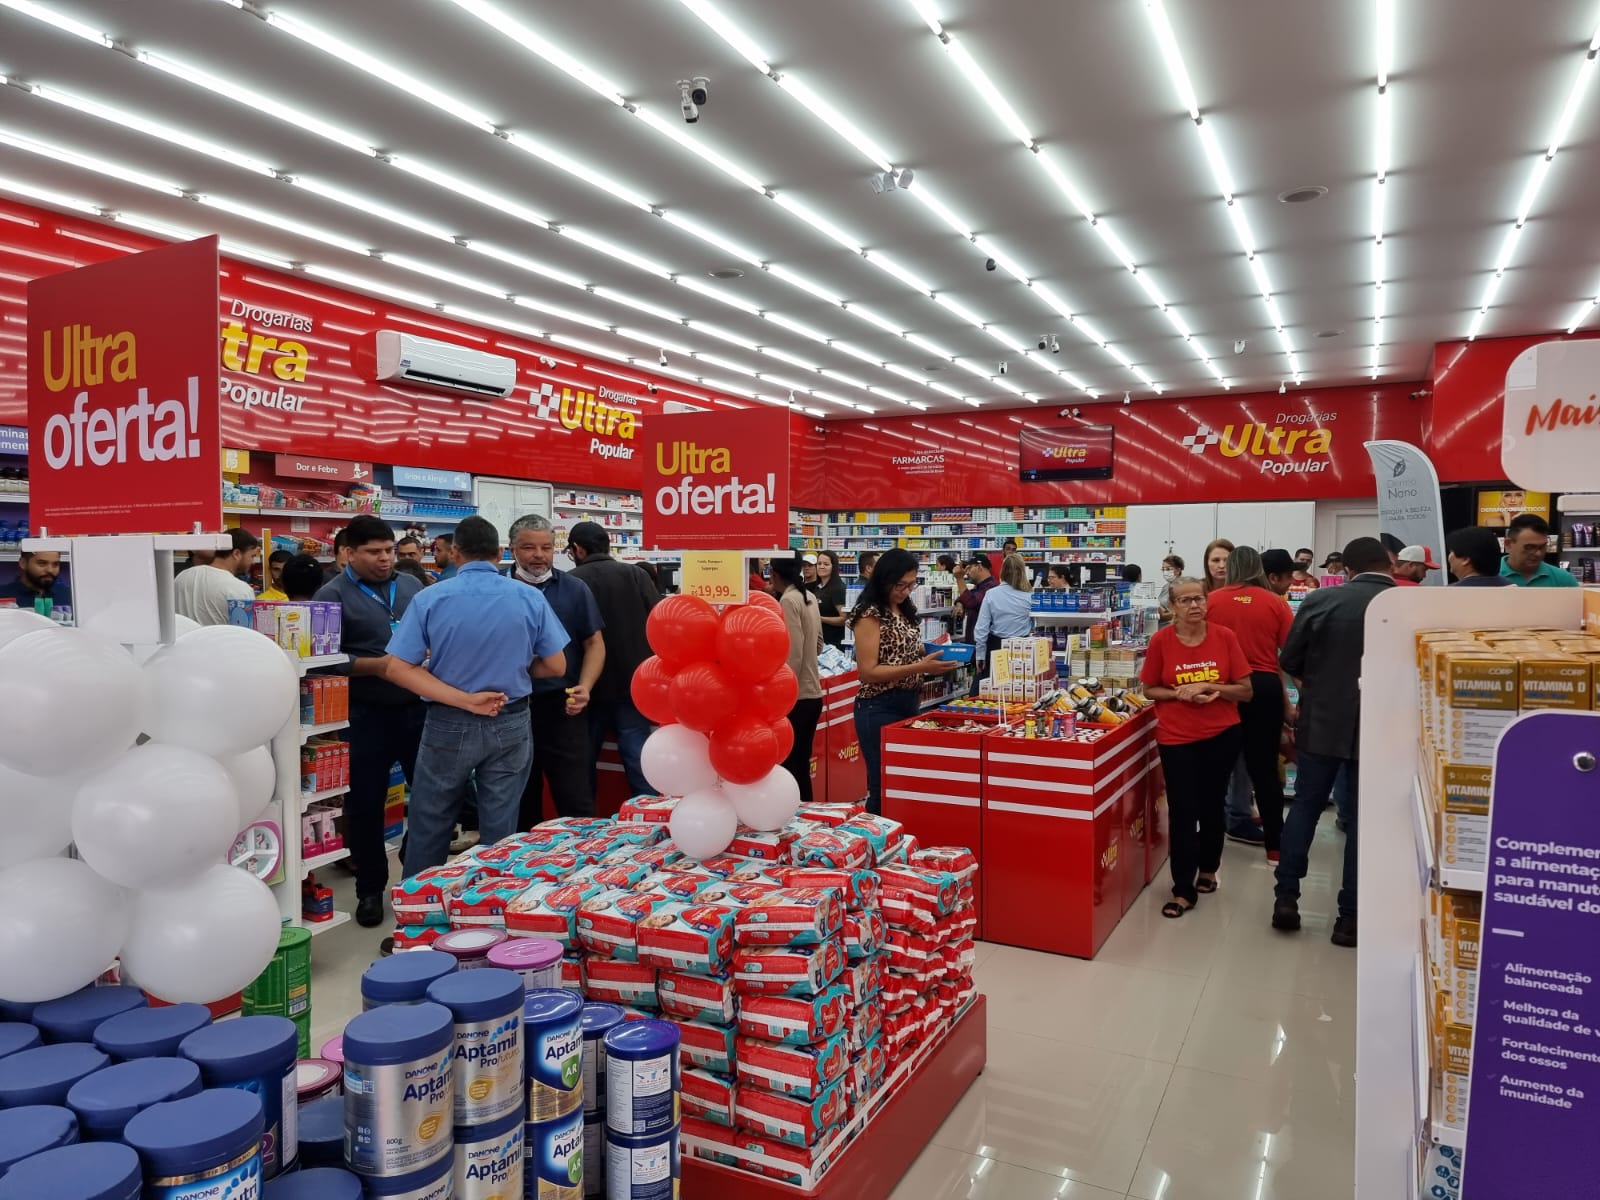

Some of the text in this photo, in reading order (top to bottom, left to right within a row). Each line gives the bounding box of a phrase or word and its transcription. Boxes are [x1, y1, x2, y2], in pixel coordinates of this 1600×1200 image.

[231, 299, 312, 333] Drogarias
[43, 324, 137, 392] Ultra
[219, 377, 307, 412] Popular
[599, 386, 637, 405] Drogarias
[43, 376, 200, 470] oferta!
[559, 388, 635, 440] Ultra
[1276, 412, 1337, 425] Drogarias
[1525, 394, 1600, 436] Mai
[590, 438, 634, 460] Popular
[1219, 423, 1333, 458] Ultra
[656, 441, 730, 475] Ultra
[892, 455, 945, 464] FARMARCAS
[1053, 447, 1087, 458] Ultra
[296, 462, 339, 475] Dor e Febre
[1260, 458, 1329, 477] Popular
[655, 473, 776, 515] oferta!
[1388, 488, 1418, 499] Nano
[698, 585, 730, 598] 19,99
[1183, 660, 1217, 670] farmácia
[1176, 667, 1220, 684] mais
[1453, 680, 1513, 691] VITAMINA D
[1523, 680, 1586, 692] VITAMINA D
[1495, 856, 1506, 867] a
[1494, 874, 1534, 888] para
[1493, 891, 1573, 911] saudável
[1504, 962, 1592, 984] Alimentação
[1504, 975, 1583, 996] balanceada
[1503, 999, 1580, 1021] Melhora da
[456, 1029, 489, 1040] DANONE
[1502, 1013, 1570, 1032] qualidade
[1573, 1024, 1592, 1036] de
[454, 1030, 517, 1062] Aptamil
[1501, 1050, 1568, 1070] dos ossos
[405, 1062, 438, 1079] DANONE
[565, 1063, 577, 1079] AR
[1500, 1075, 1585, 1099] Aumento da
[1499, 1086, 1573, 1109] imunidade
[466, 1142, 522, 1180] Aptamil
[468, 1146, 500, 1159] DANONE
